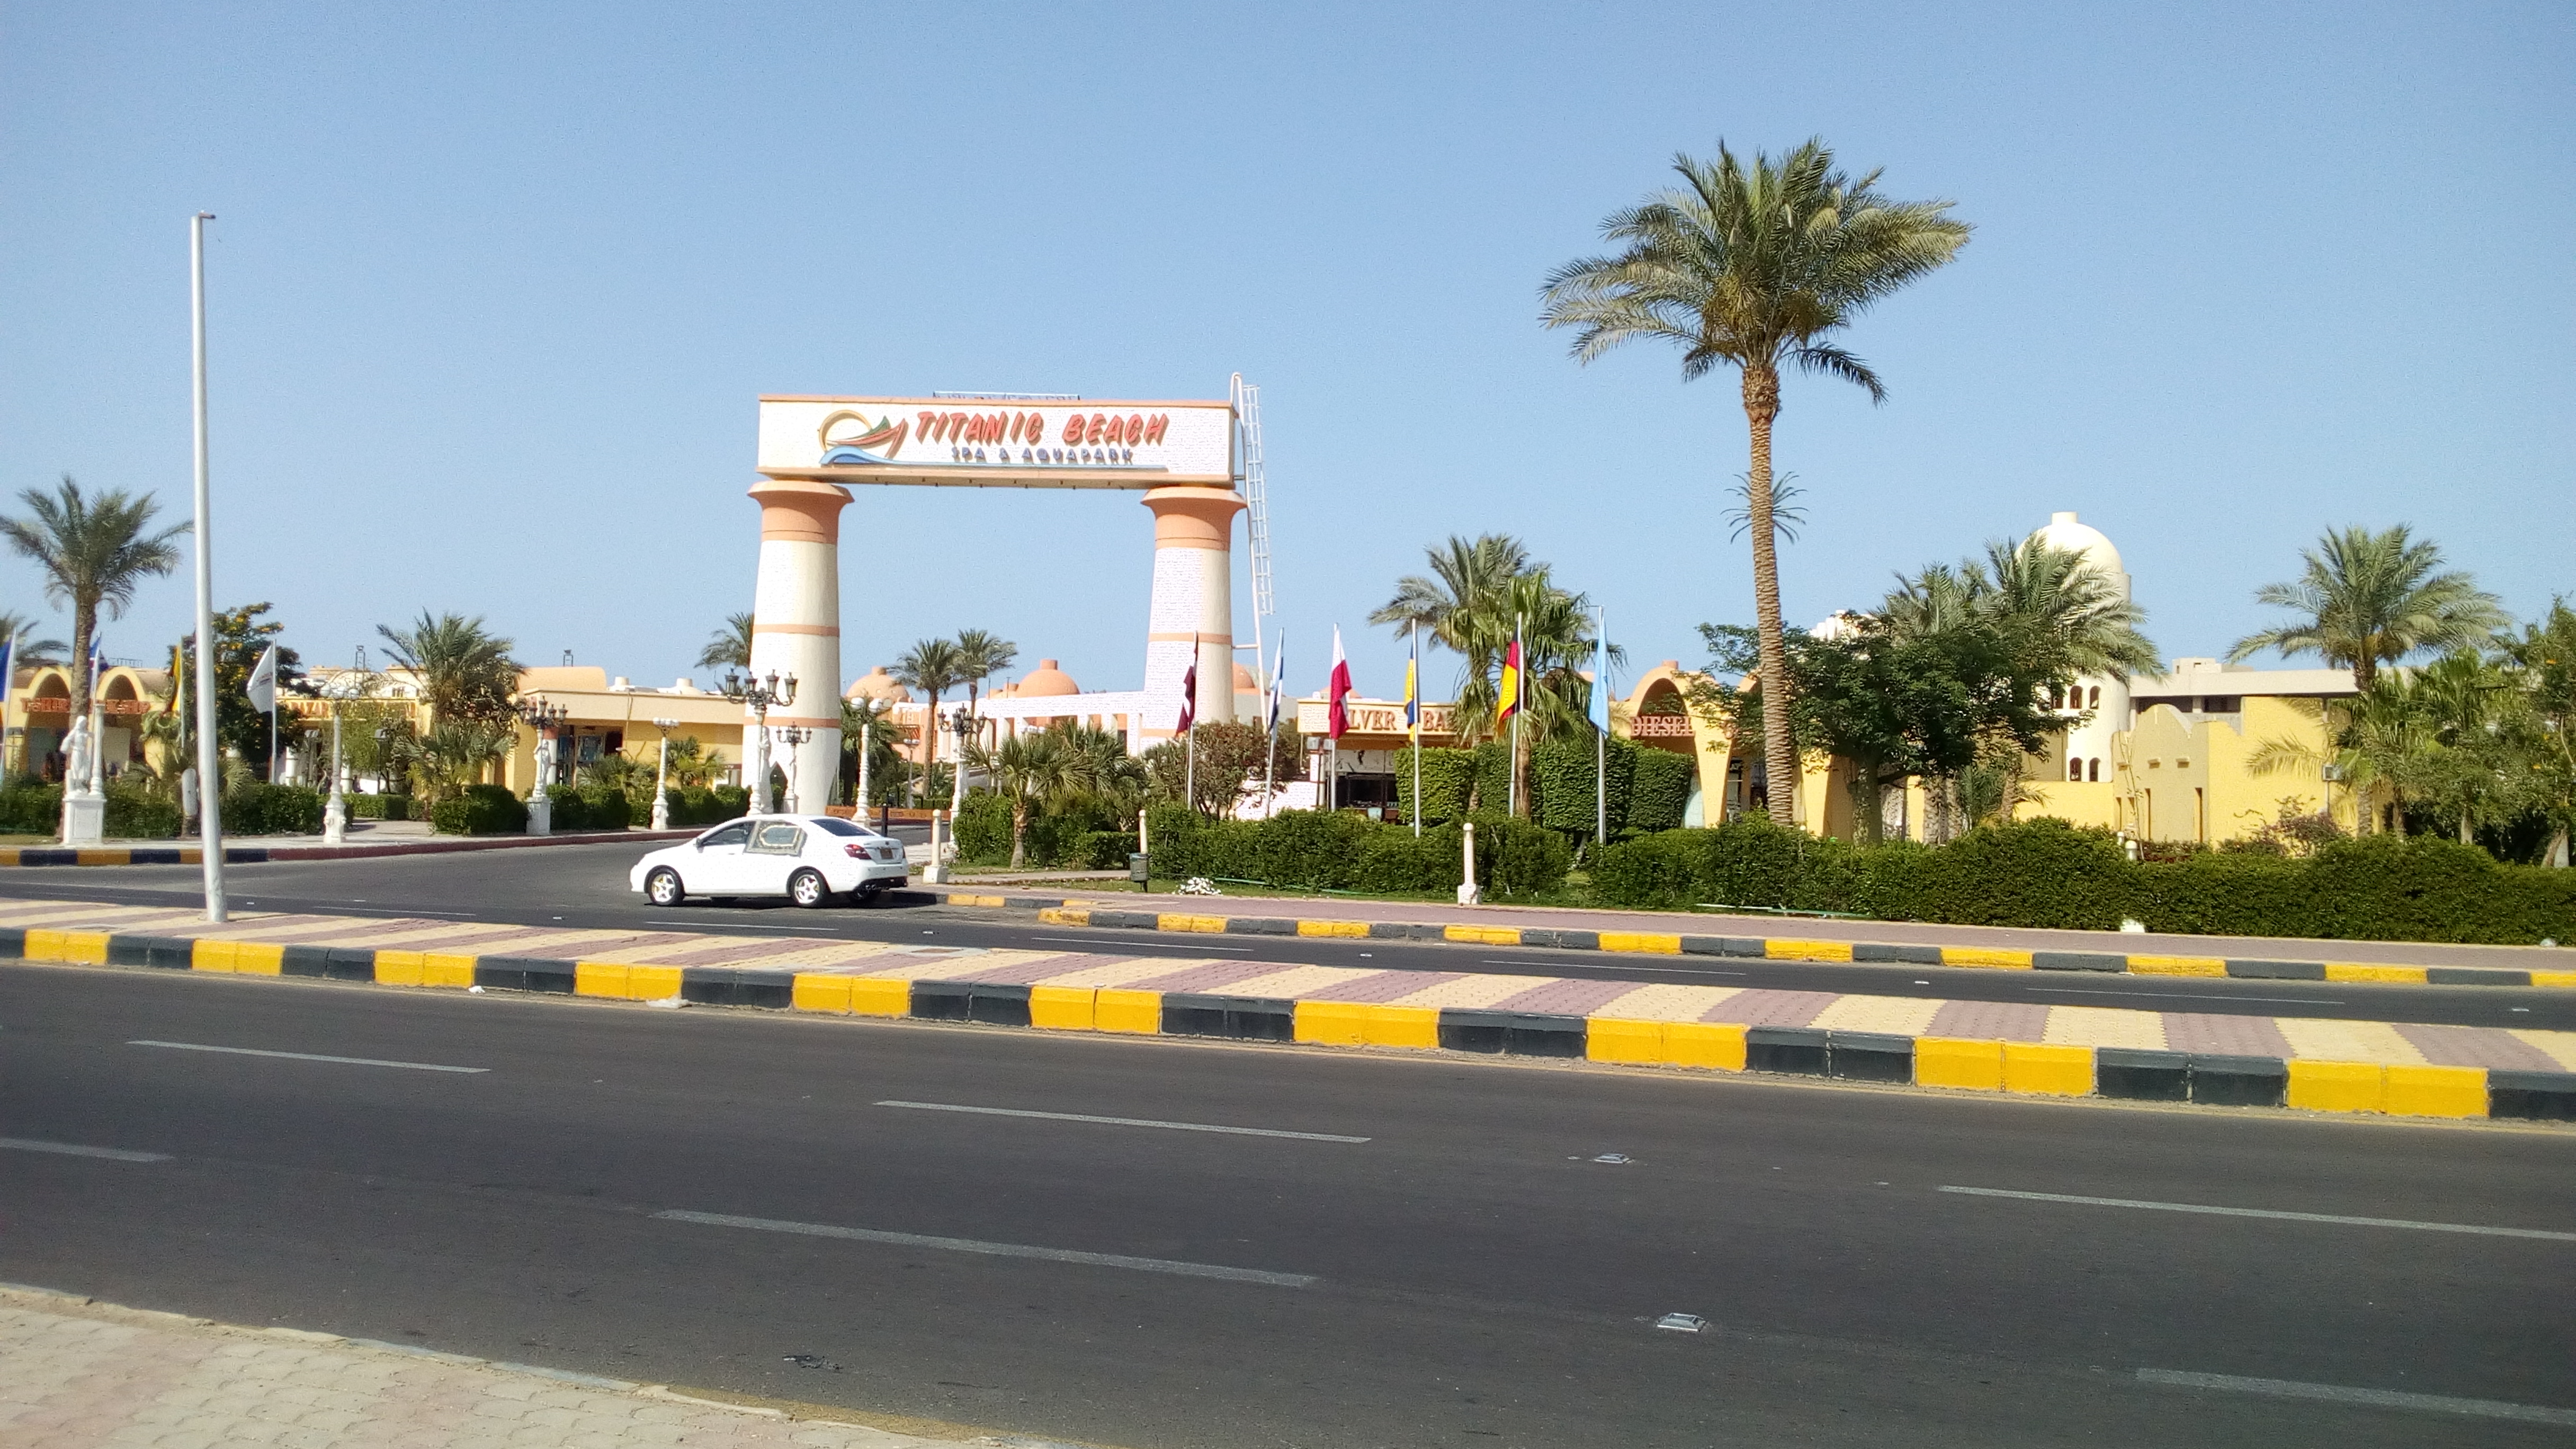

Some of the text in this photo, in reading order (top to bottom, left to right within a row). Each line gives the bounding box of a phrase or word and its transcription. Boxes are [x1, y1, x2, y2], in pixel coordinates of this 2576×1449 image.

[915, 410, 1169, 446] TITANIC BEACH
[951, 446, 985, 460] SPA
[1022, 448, 1132, 462] AQUAPARK
[1347, 709, 1397, 730] LVER
[1631, 715, 1695, 737] DIESEL
